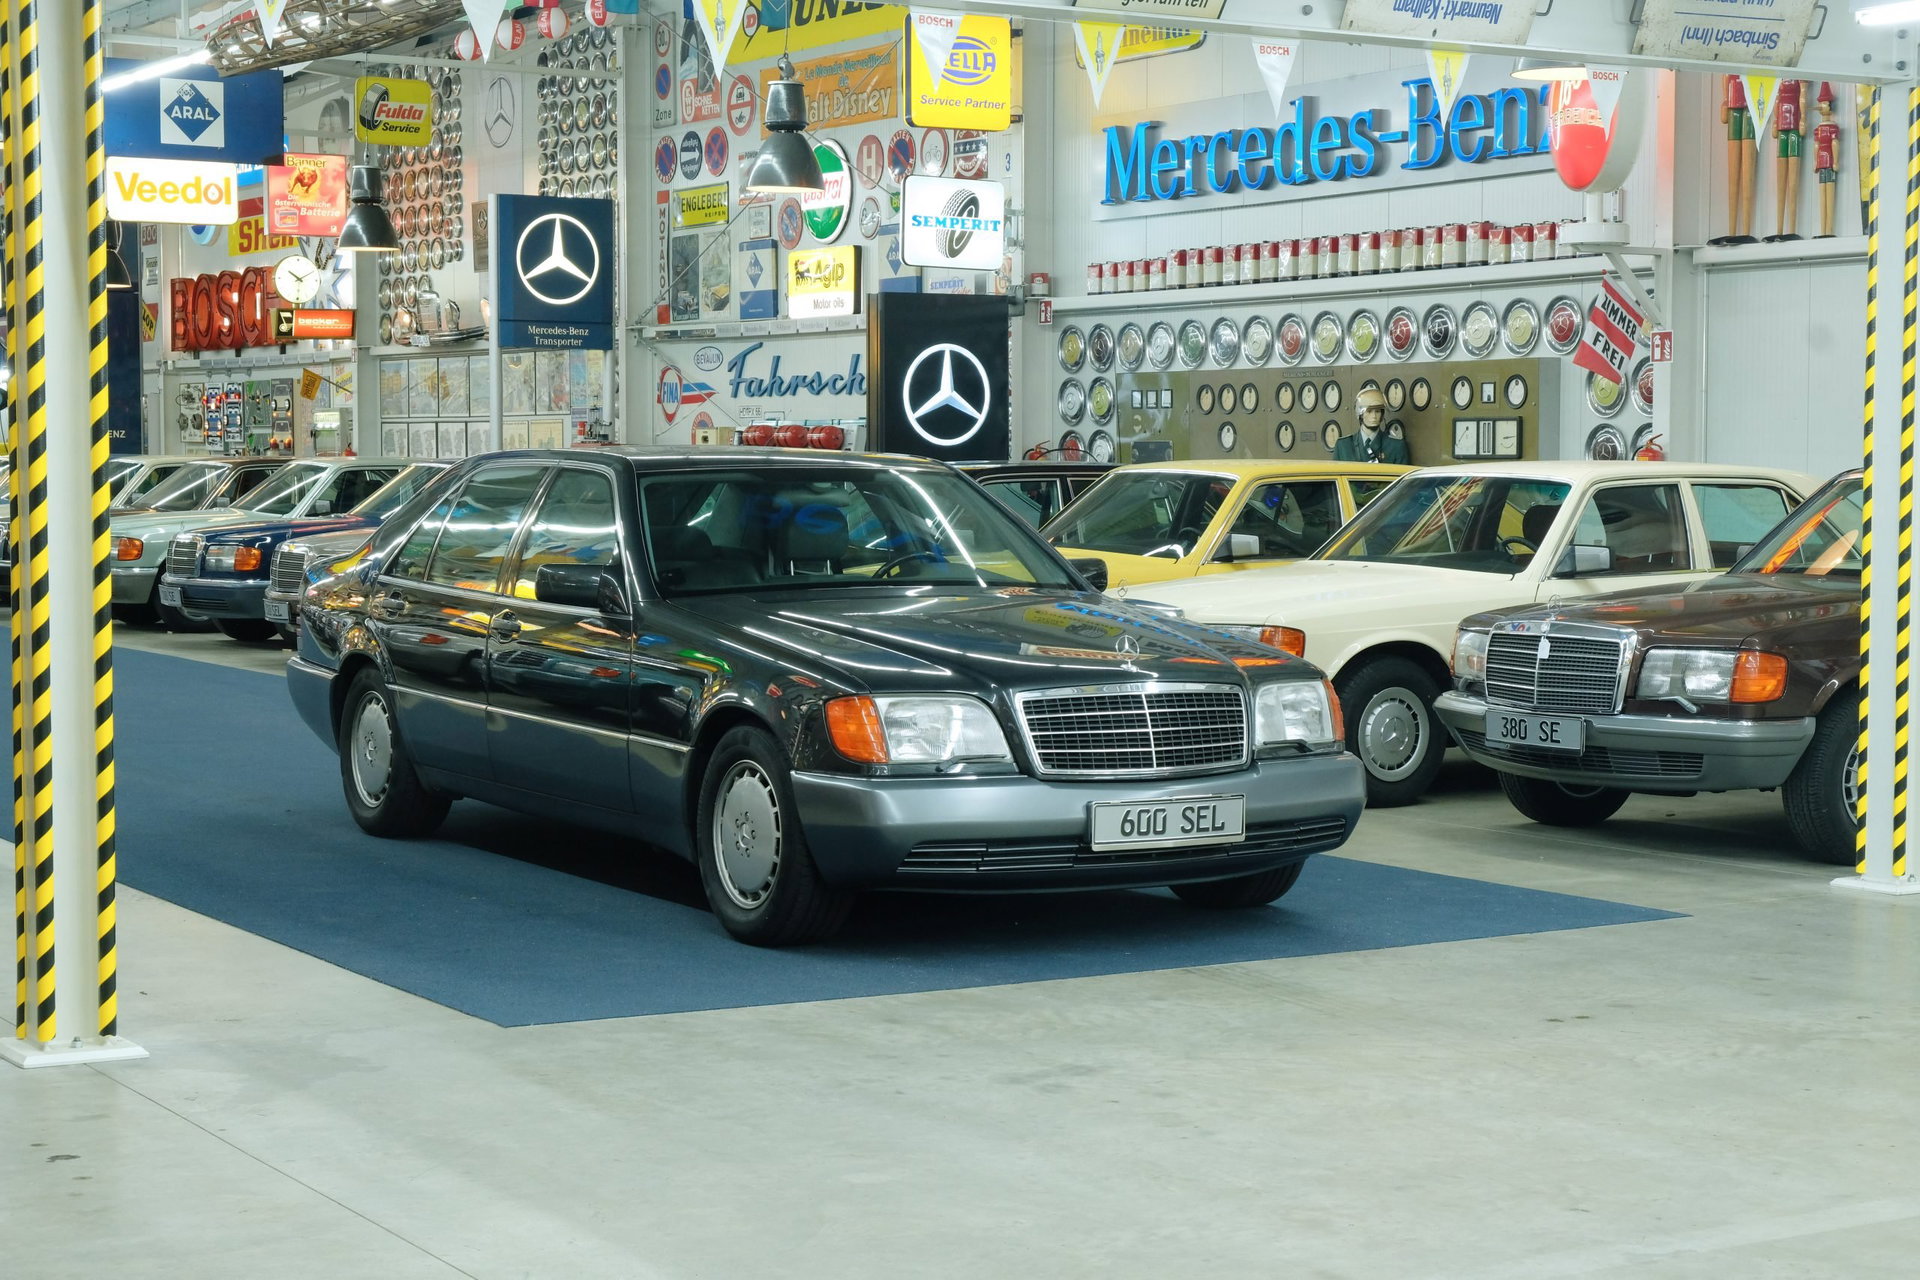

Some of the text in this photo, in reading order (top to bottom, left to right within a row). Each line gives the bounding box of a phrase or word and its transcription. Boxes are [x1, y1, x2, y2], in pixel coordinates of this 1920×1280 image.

[594, 0, 604, 19] ELA
[767, 0, 885, 33] UNL
[541, 10, 549, 33] ELAN
[918, 14, 953, 28] BOSCH
[513, 23, 523, 44] ELAN
[1681, 25, 1780, 50] Simbach (Inn)
[1259, 44, 1290, 57] BOSCH
[945, 52, 996, 73] ELLA
[1592, 71, 1619, 81] BOSCH
[376, 102, 423, 121] Fulda
[805, 87, 891, 123] alt Disney
[920, 94, 1006, 110] Service Partner
[170, 105, 214, 120] ARAL
[655, 109, 672, 121] Zone
[381, 122, 421, 134] Service
[286, 156, 327, 168] Banner
[114, 171, 232, 206] Veedol
[681, 191, 727, 213] ENGLEBERT
[911, 214, 1001, 232] SEMPERIT
[813, 258, 845, 289] Agip
[930, 278, 965, 290] SEMPERIT
[813, 297, 845, 310] Motor oils
[298, 317, 340, 325] becker
[1601, 293, 1637, 341] ZIMMER
[527, 325, 589, 337] Mercedes-Benz
[533, 336, 583, 347] Transporter
[1592, 330, 1625, 371] FREI
[662, 382, 679, 403] FINA
[107, 429, 126, 439] ENZ
[1500, 717, 1561, 744] 380 SE
[1120, 805, 1226, 837] 600 SEL
